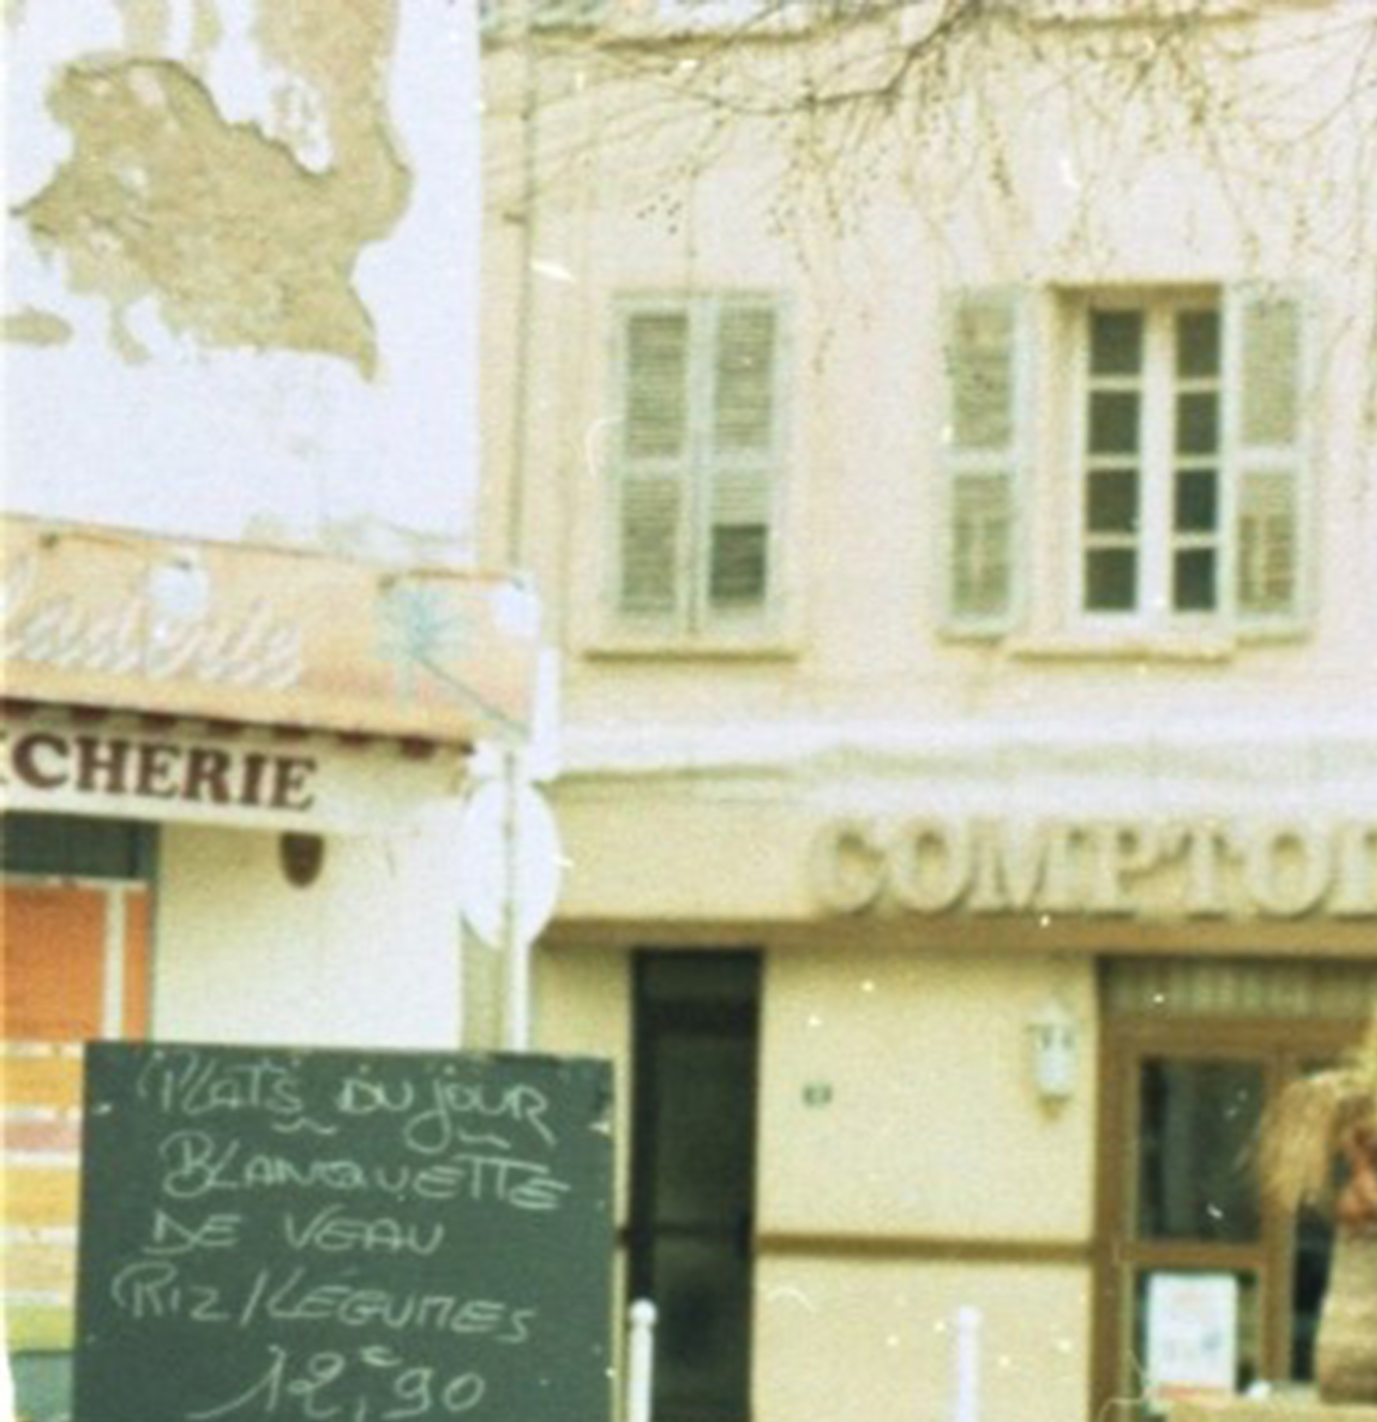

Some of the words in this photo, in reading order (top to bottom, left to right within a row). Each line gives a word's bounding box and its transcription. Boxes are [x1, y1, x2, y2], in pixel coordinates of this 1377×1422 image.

[0, 730, 317, 811] CHERIE
[159, 1129, 571, 1210] BLANQUETTE
[142, 1210, 243, 1256] DE
[284, 1204, 444, 1255] VEAU
